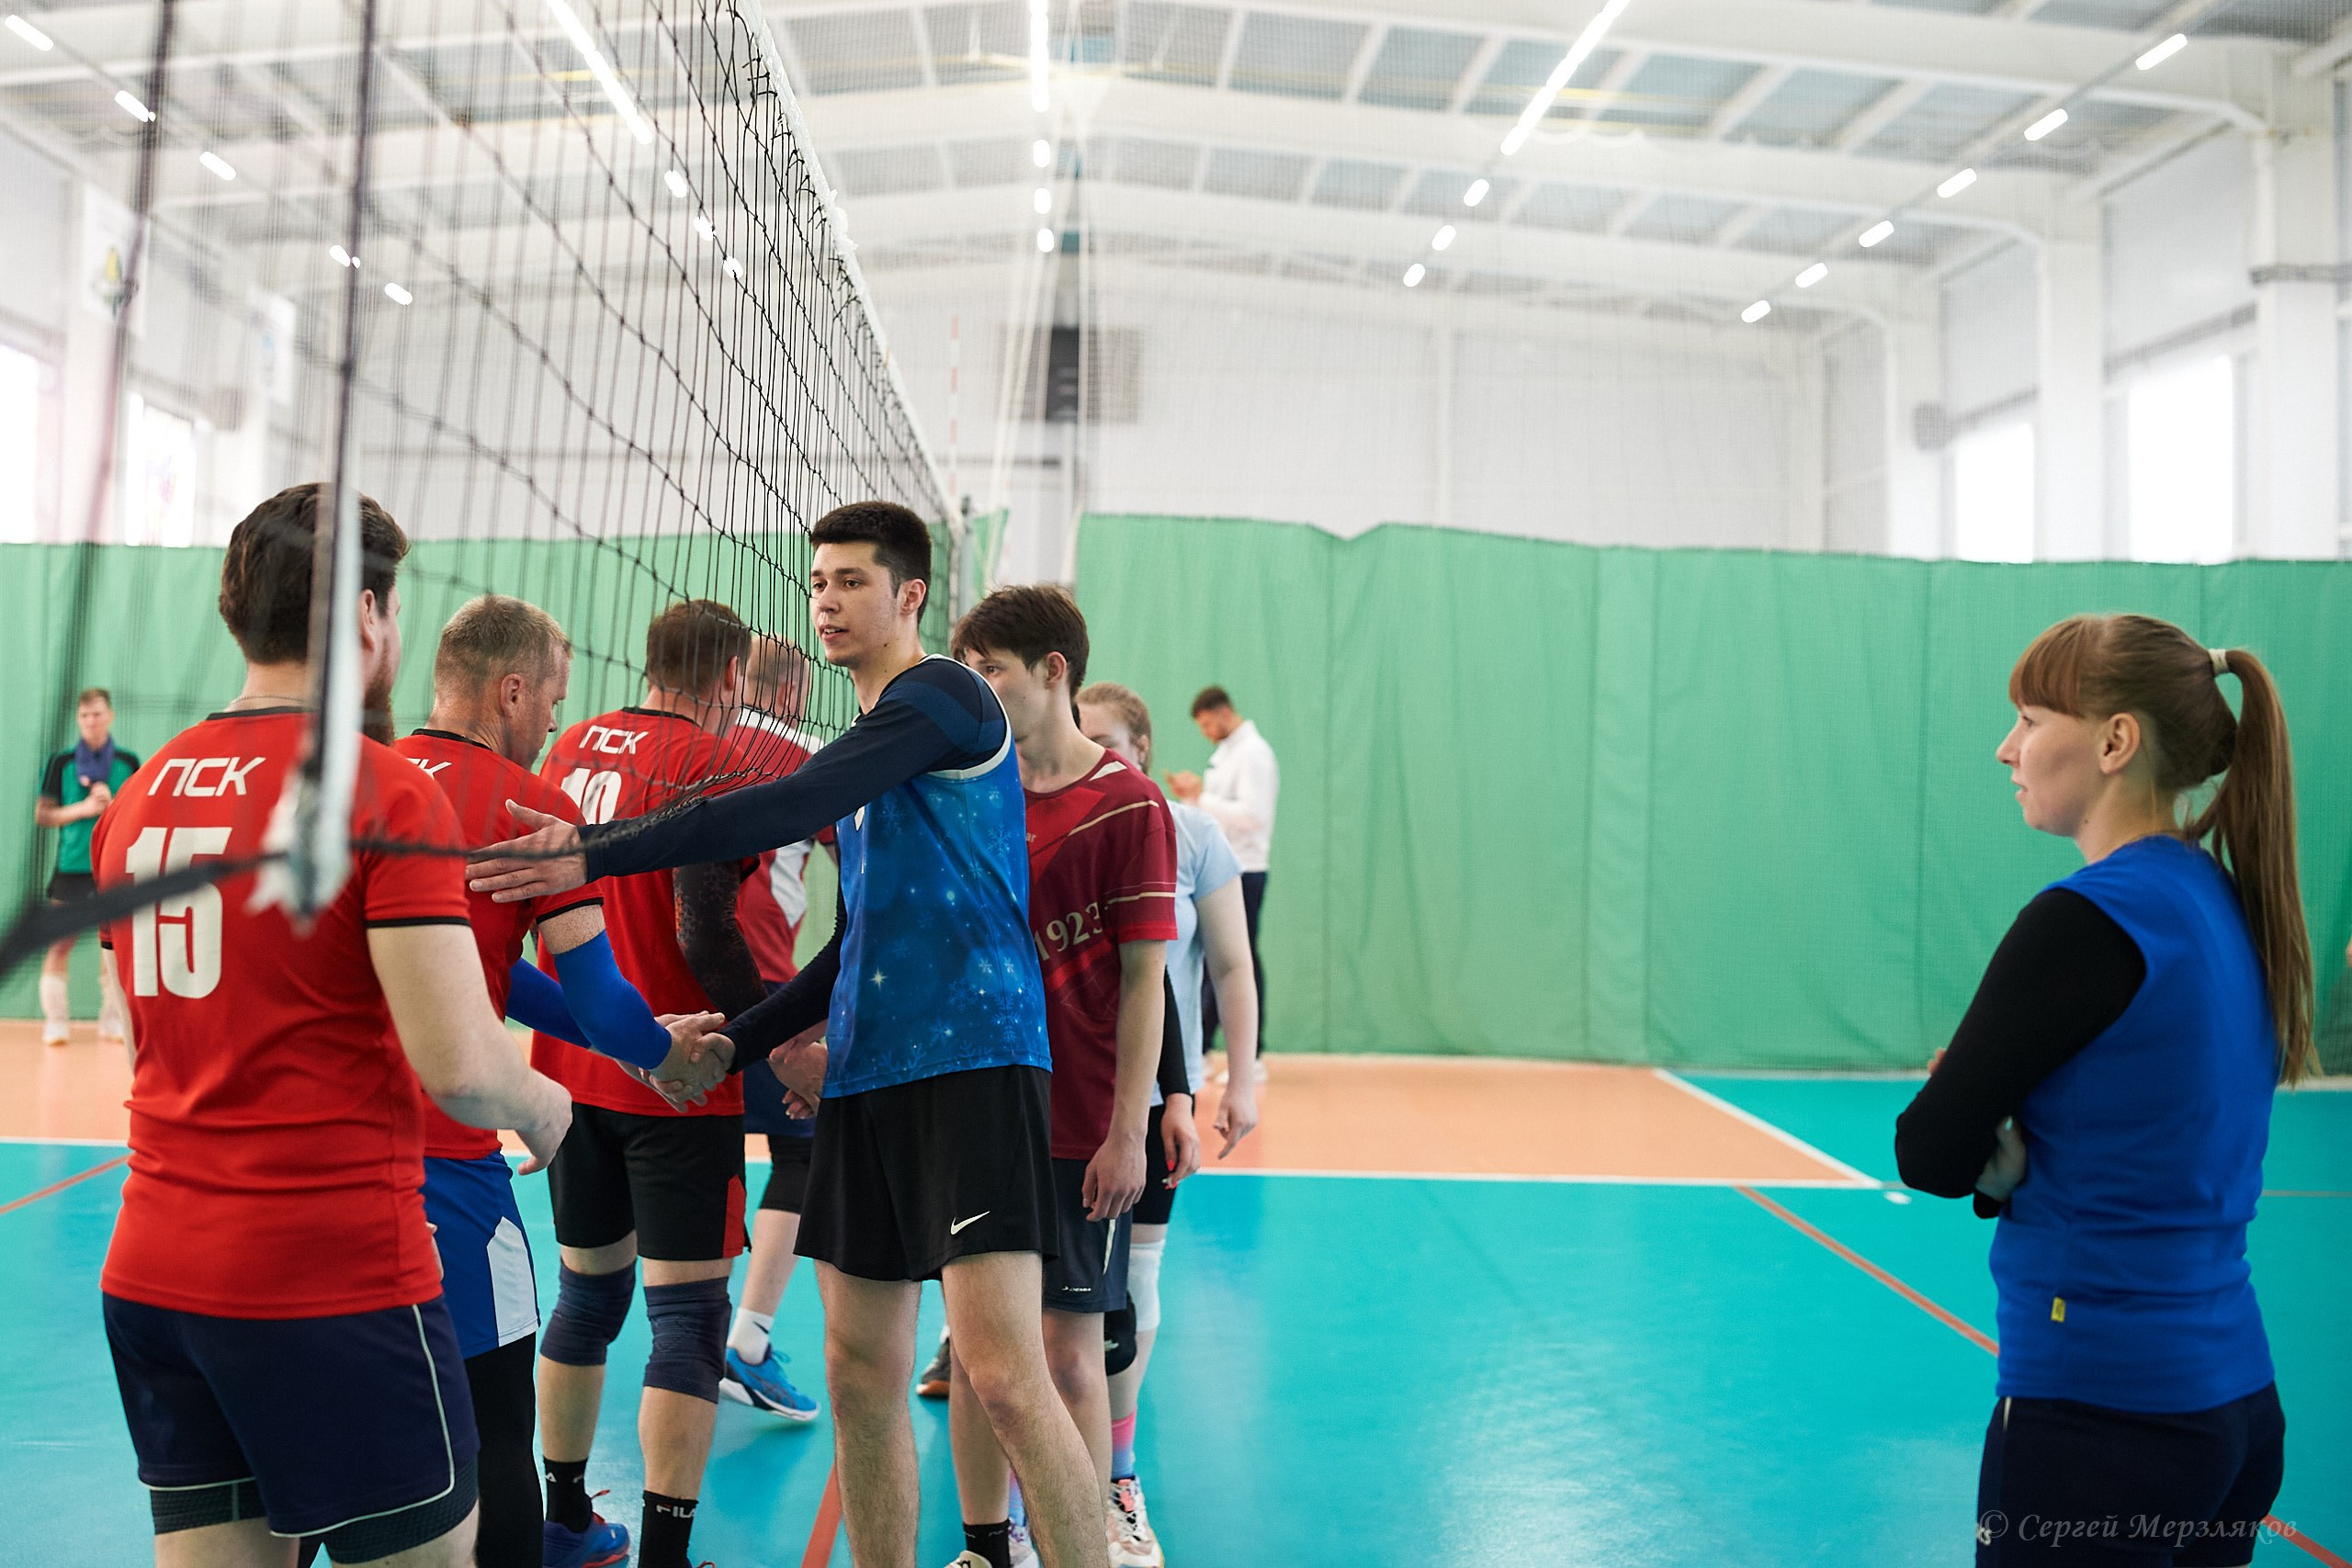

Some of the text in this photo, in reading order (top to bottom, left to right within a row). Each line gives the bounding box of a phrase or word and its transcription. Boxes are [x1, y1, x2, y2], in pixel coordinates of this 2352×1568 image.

[579, 725, 649, 754] ПСК
[148, 757, 266, 796] ПСК
[125, 827, 232, 998] 15
